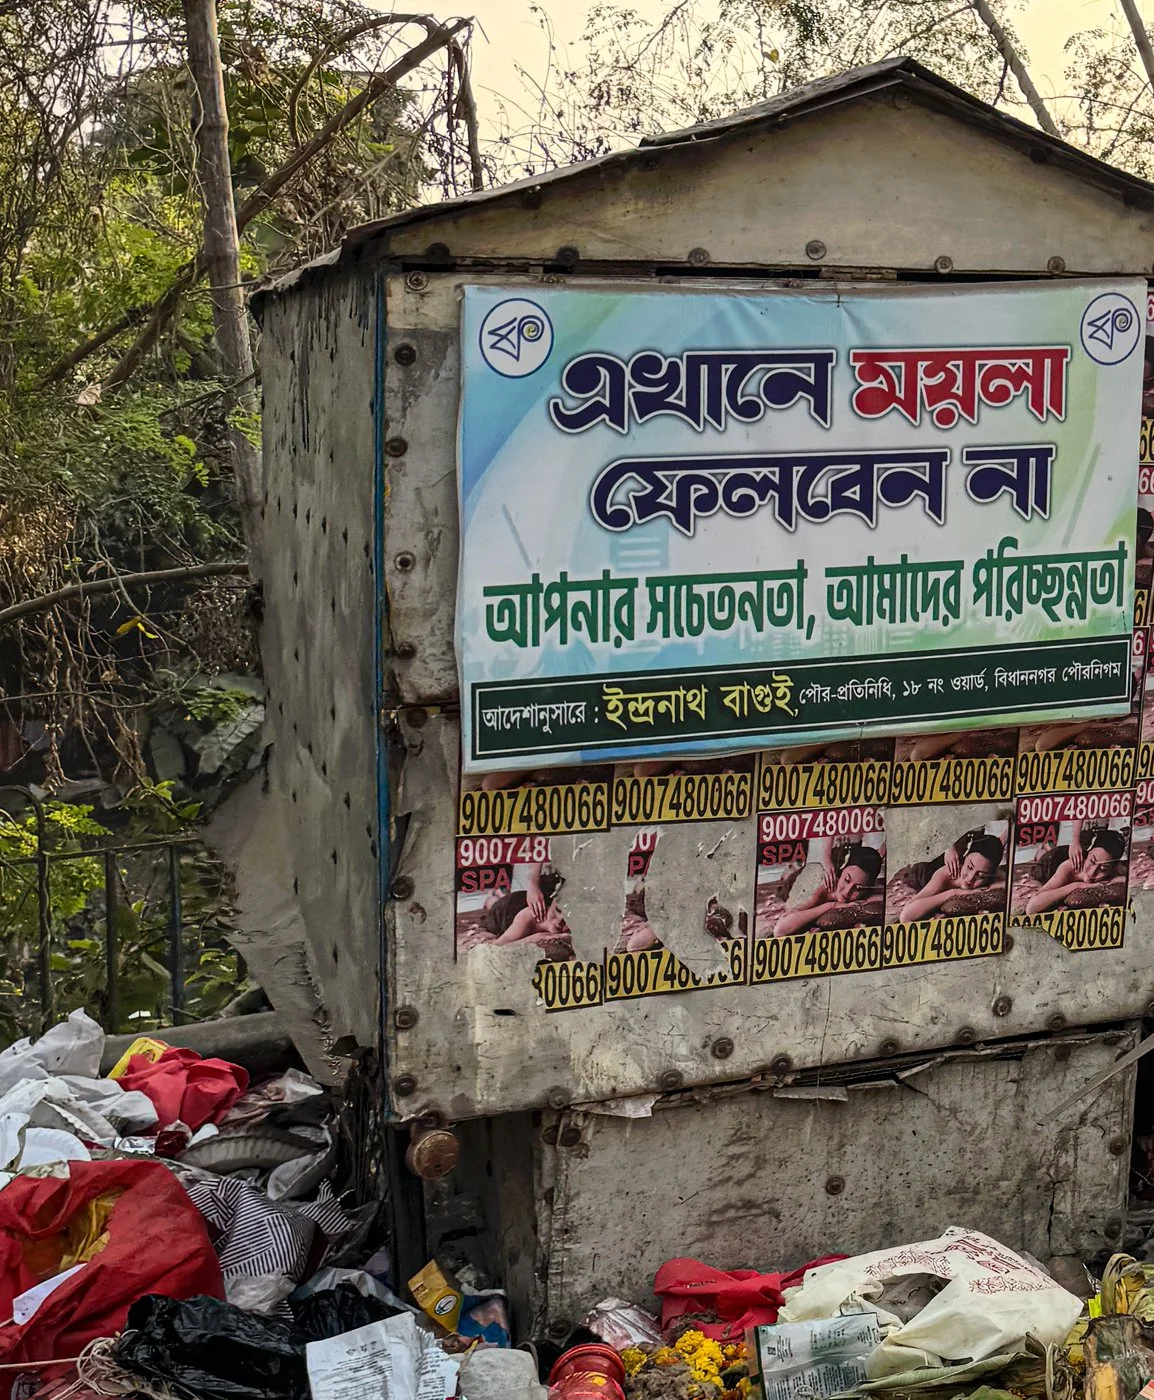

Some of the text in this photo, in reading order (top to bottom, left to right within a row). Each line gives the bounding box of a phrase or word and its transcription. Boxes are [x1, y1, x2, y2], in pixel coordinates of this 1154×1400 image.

[550, 345, 1071, 435] এখানে ময়লা
[590, 443, 1056, 536] ফেলবেন না
[484, 567, 640, 648] আপনার
[647, 558, 816, 641] সচেতনতা,
[825, 554, 964, 627] আমাদের
[971, 536, 1128, 622] পরিচ্ছন্নতা
[482, 700, 586, 733] আদেশানুসারে
[602, 683, 708, 731] ইন্দ্রনাথ
[720, 671, 799, 718] বাগুই,
[799, 676, 896, 704] পৌর-প্রতিনিধি,
[903, 682, 922, 697] ১৮
[927, 678, 944, 694] নং
[951, 667, 988, 693] ওয়ার্ড,
[994, 665, 1056, 688] বিধাননগর
[1062, 658, 1122, 683] পৌরনিগম
[761, 763, 889, 808] 9007480066
[892, 758, 1012, 803] 9007480066
[1017, 750, 1133, 793] 9007480066
[462, 784, 605, 834] 9007480066
[614, 776, 749, 823] 9007480066
[1020, 794, 1131, 825] 9007480066
[461, 836, 550, 866] 900748
[763, 843, 806, 866] SPA
[1019, 825, 1058, 847] SPA
[462, 869, 512, 894] SPA
[755, 928, 882, 980] 9007480066
[883, 912, 1001, 964] 9007480066
